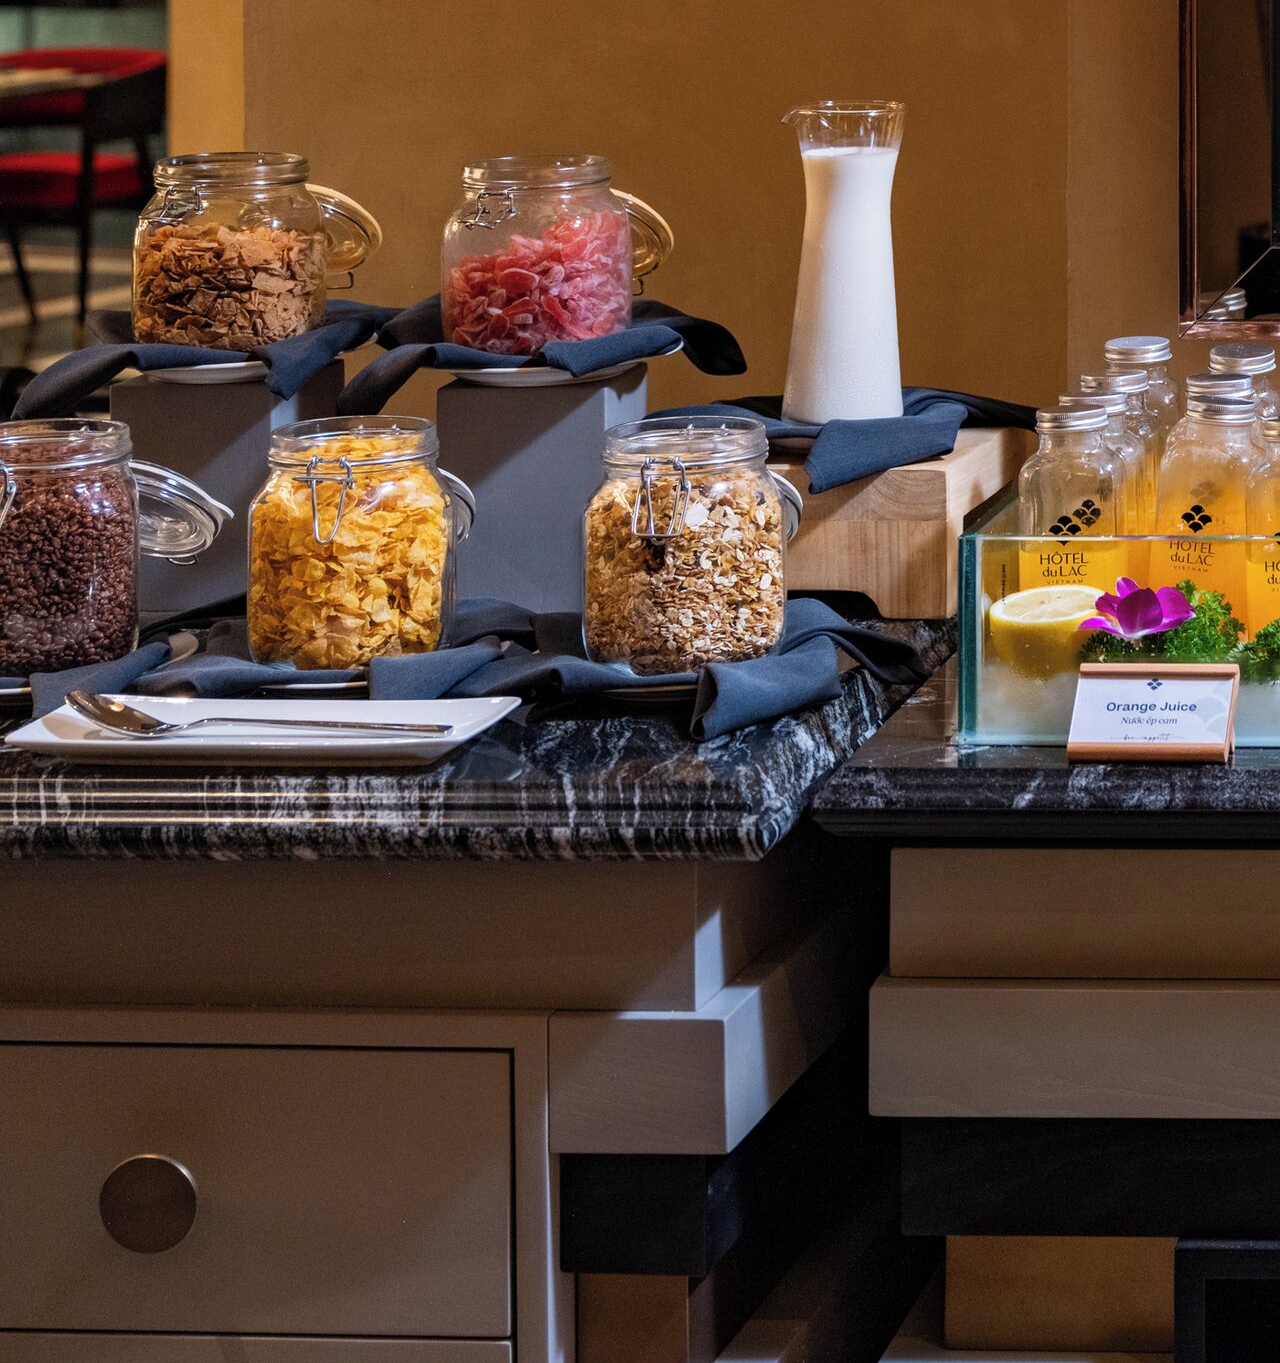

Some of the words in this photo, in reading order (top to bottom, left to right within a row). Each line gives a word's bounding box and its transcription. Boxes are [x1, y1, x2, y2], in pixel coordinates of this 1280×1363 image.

[1040, 551, 1089, 565] HÔTEL
[1106, 702, 1157, 714] Orange
[1160, 701, 1197, 712] Juice
[1158, 717, 1178, 725] cam
